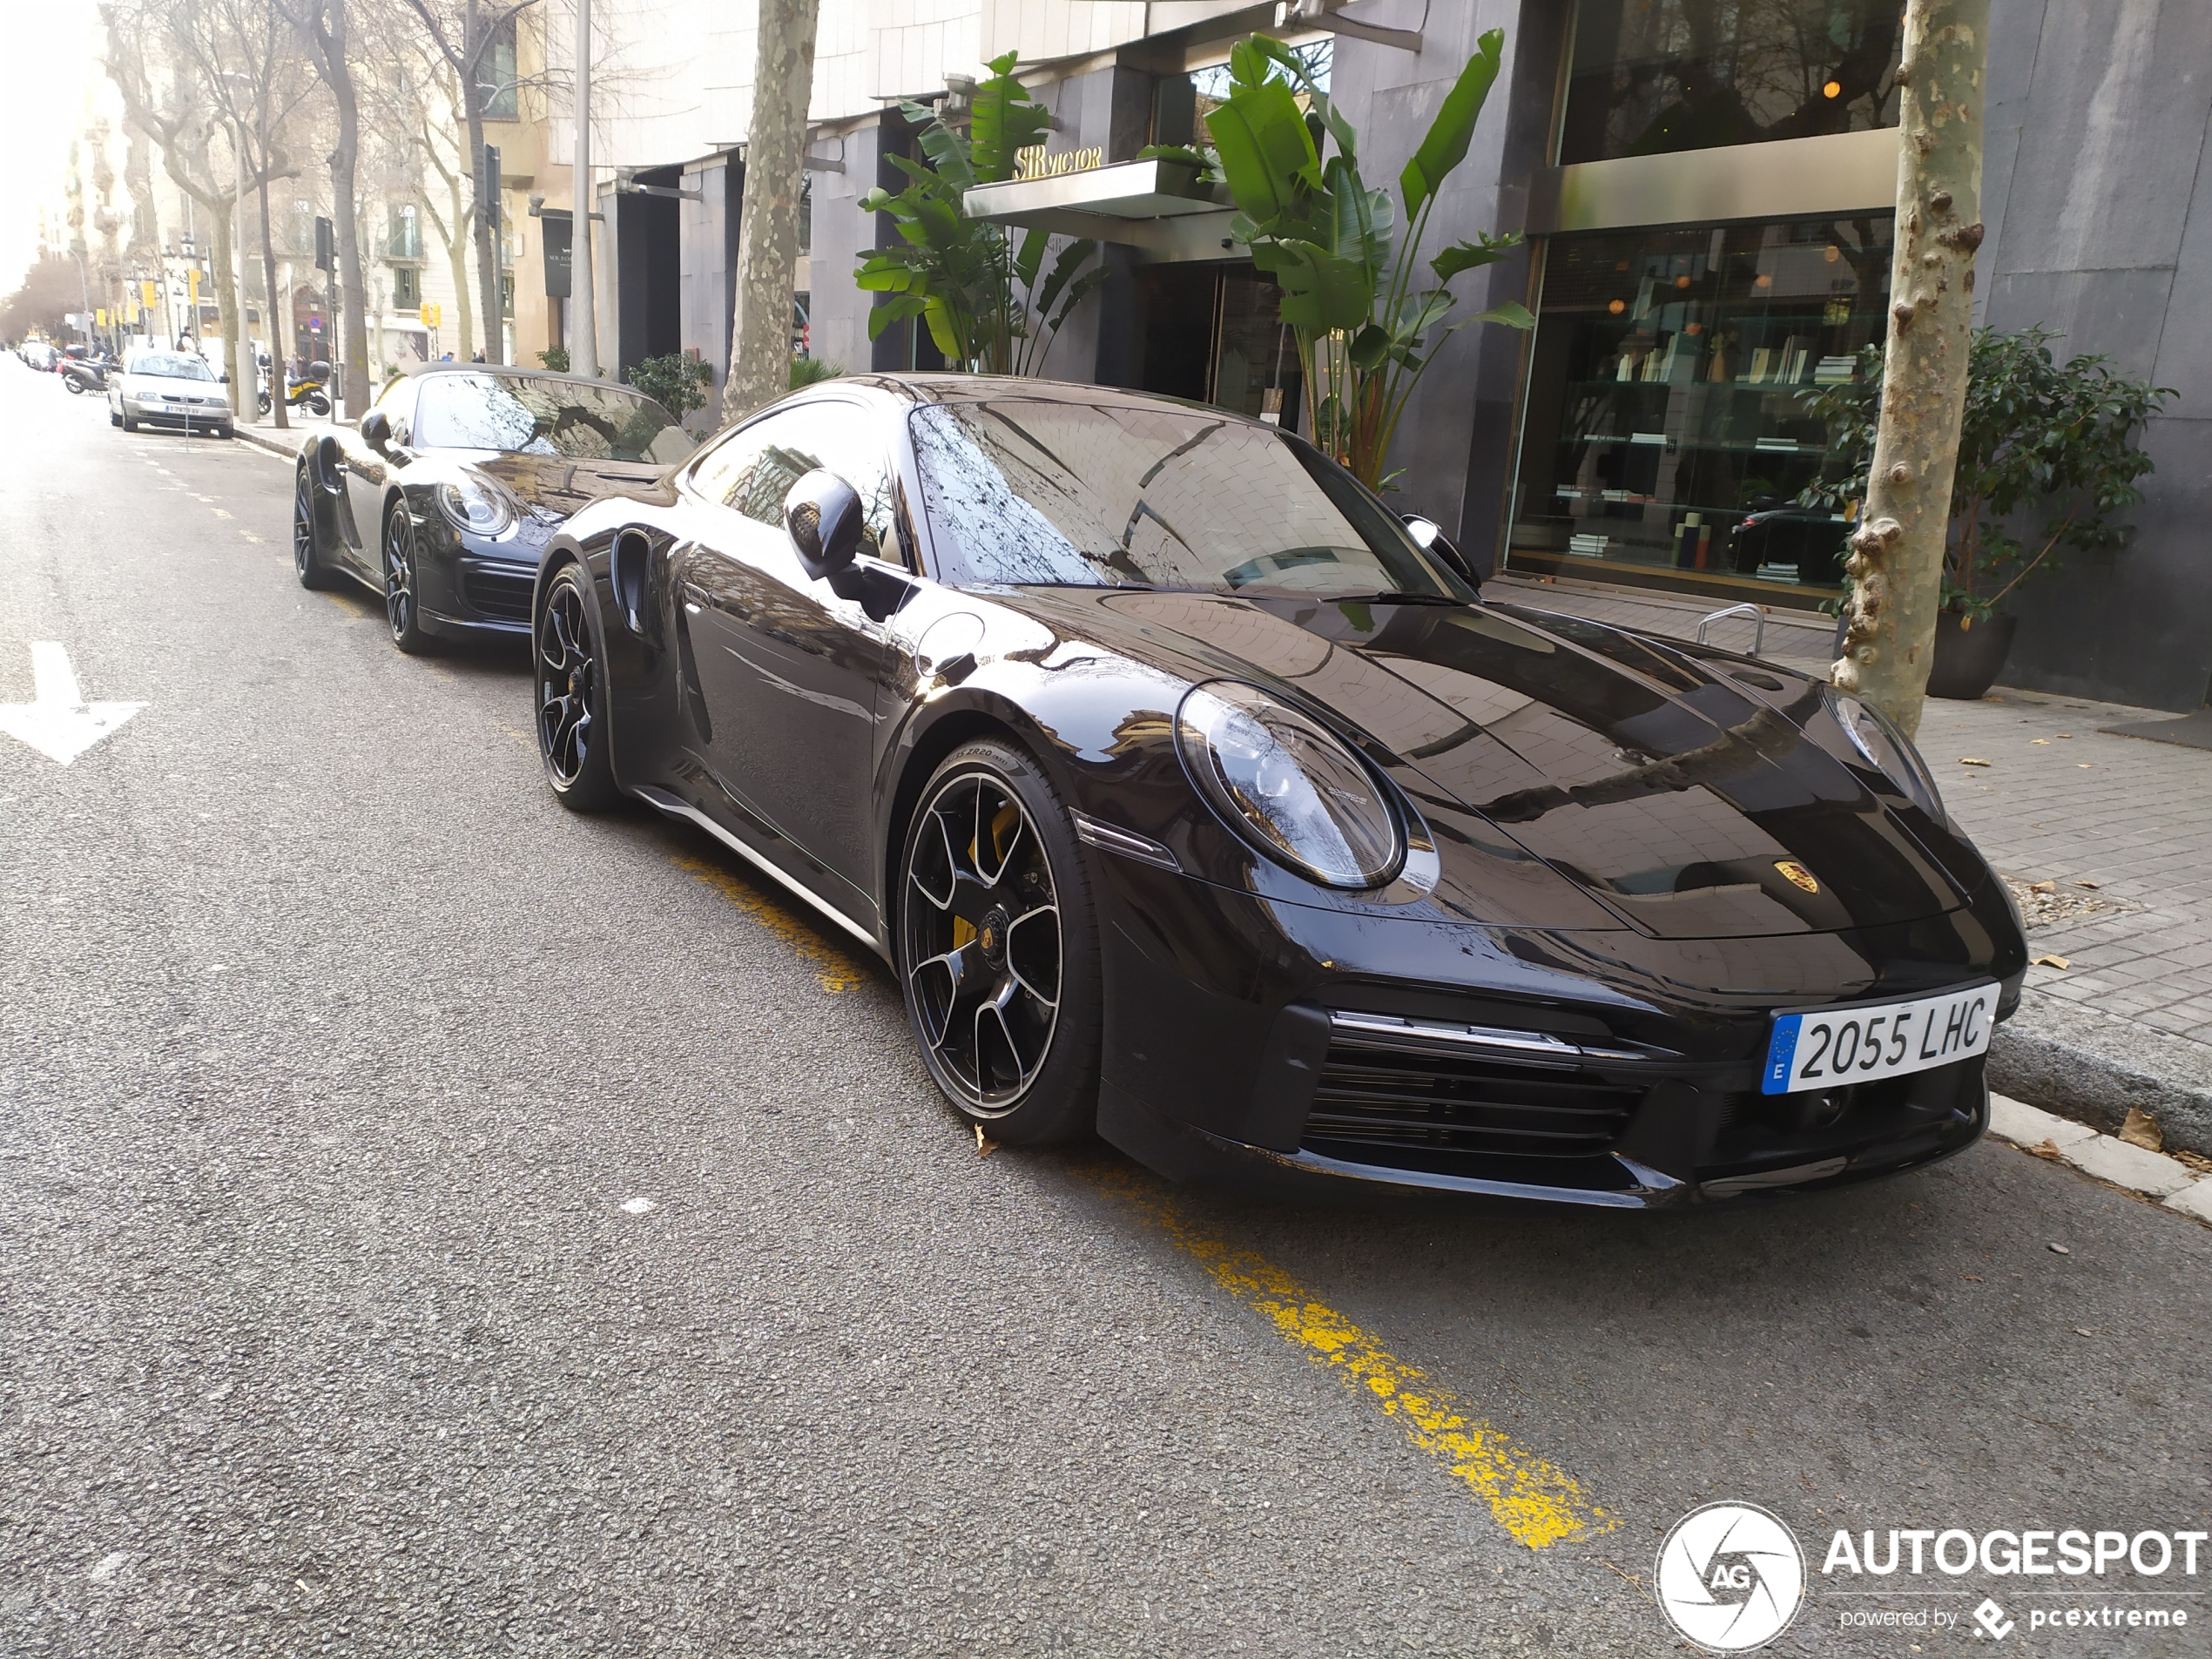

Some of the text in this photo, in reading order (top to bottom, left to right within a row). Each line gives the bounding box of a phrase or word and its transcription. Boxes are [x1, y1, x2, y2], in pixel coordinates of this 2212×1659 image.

[1048, 146, 1103, 175] VICTOR
[966, 747, 993, 757] ZR20
[1773, 997, 1986, 1080] E 2055 LHC
